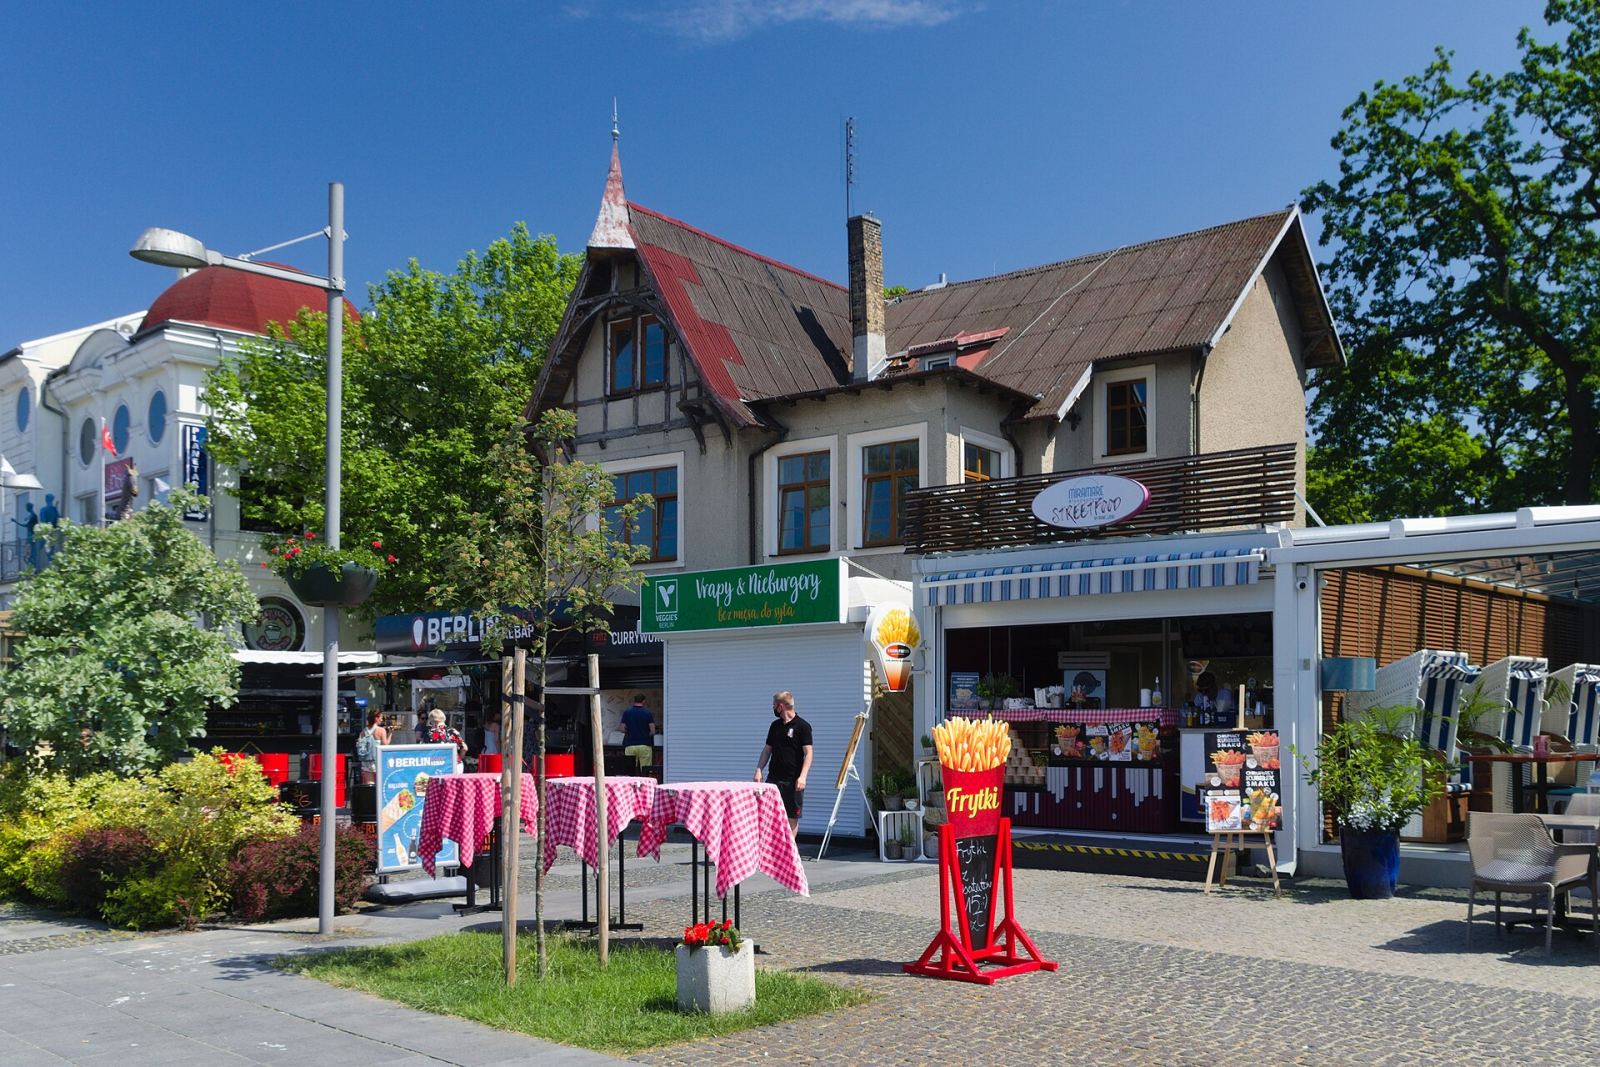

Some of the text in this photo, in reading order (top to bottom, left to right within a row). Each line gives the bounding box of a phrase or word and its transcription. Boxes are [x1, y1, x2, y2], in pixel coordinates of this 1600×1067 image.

[696, 569, 822, 607] Vrapy & Nieburgery
[656, 614, 678, 622] VEGGIE'S
[717, 606, 731, 622] bez
[761, 601, 772, 618] do
[775, 602, 794, 624] syta
[659, 621, 674, 629] BERLIN
[396, 757, 430, 767] BERLIN
[947, 786, 1000, 818] Frytki
[956, 839, 987, 864] Frytki
